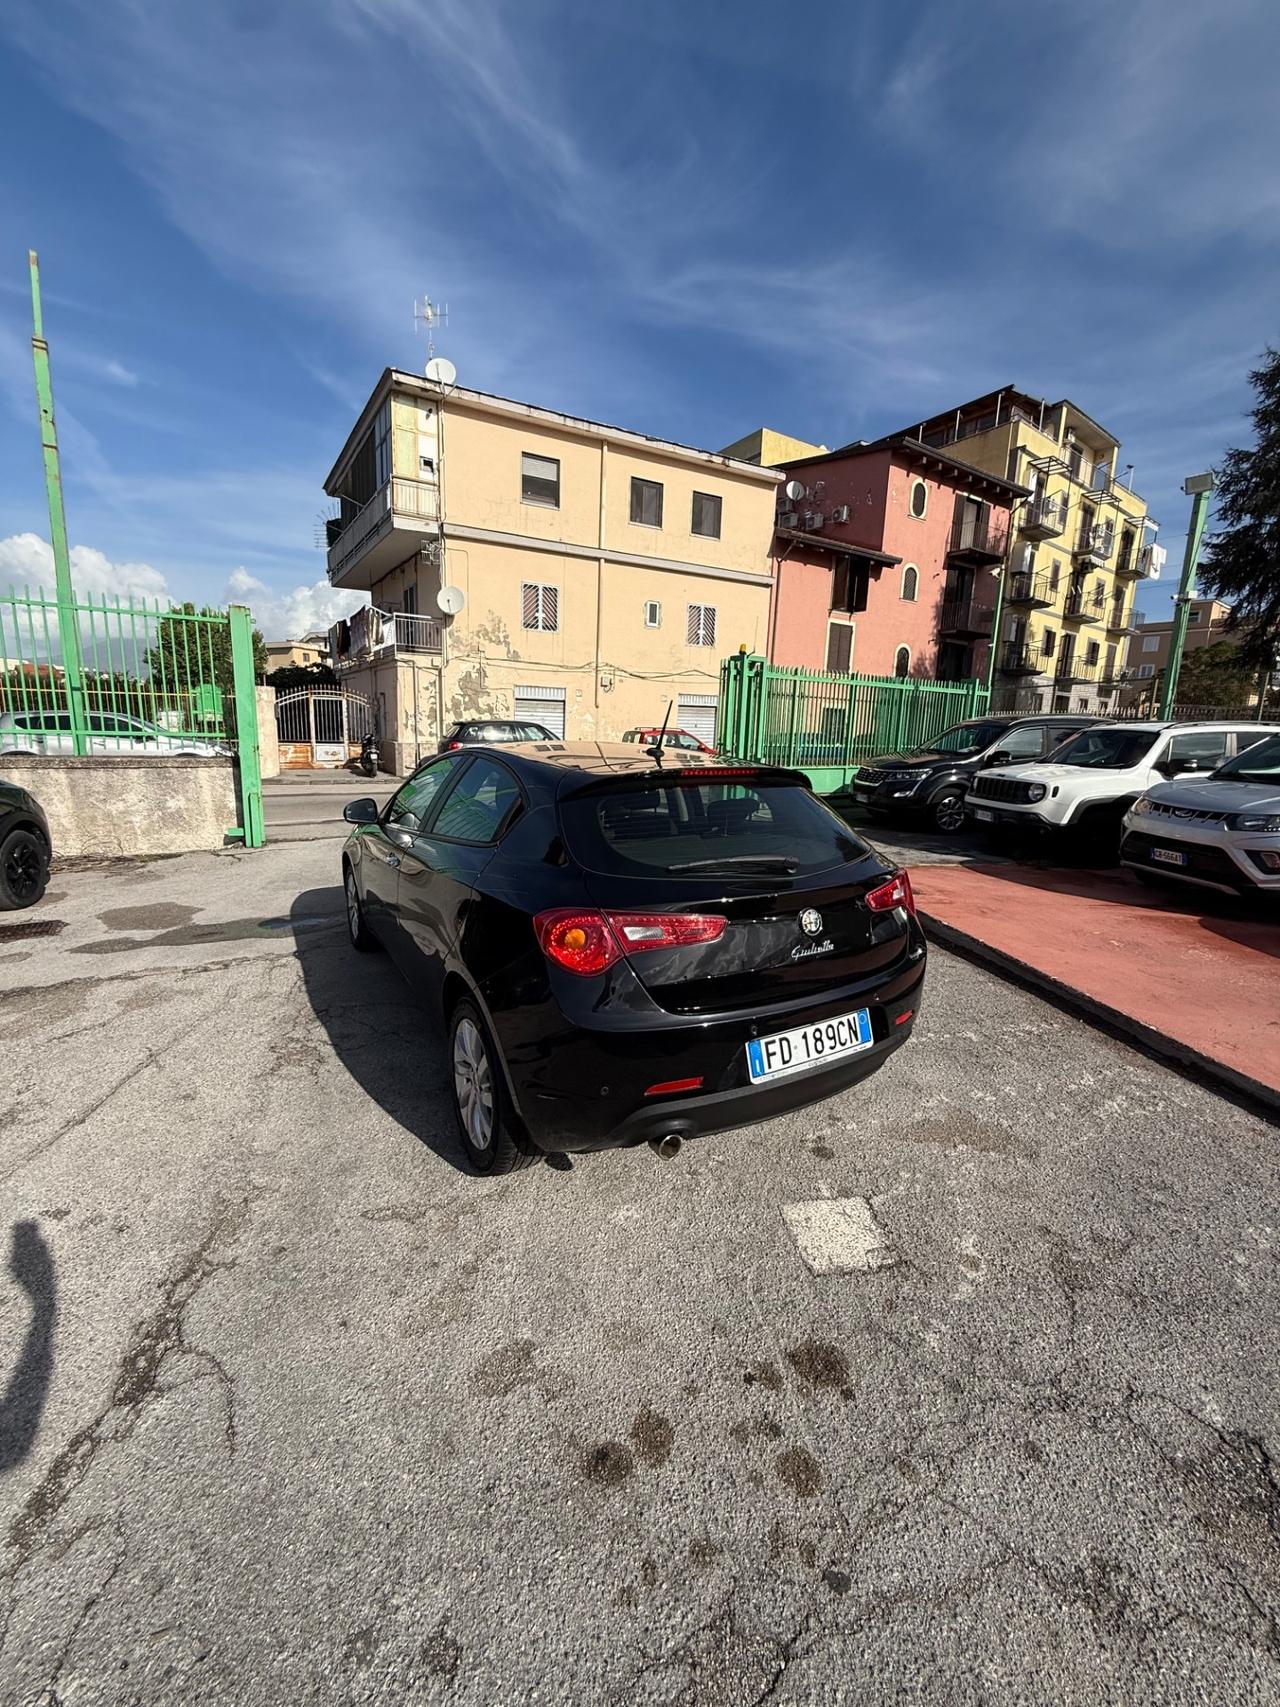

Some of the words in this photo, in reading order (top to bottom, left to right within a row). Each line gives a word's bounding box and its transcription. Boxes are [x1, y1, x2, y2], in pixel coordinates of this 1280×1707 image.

[791, 940, 834, 961] Giulietta
[764, 1036, 793, 1069] FD
[801, 1016, 859, 1058] 189CN
